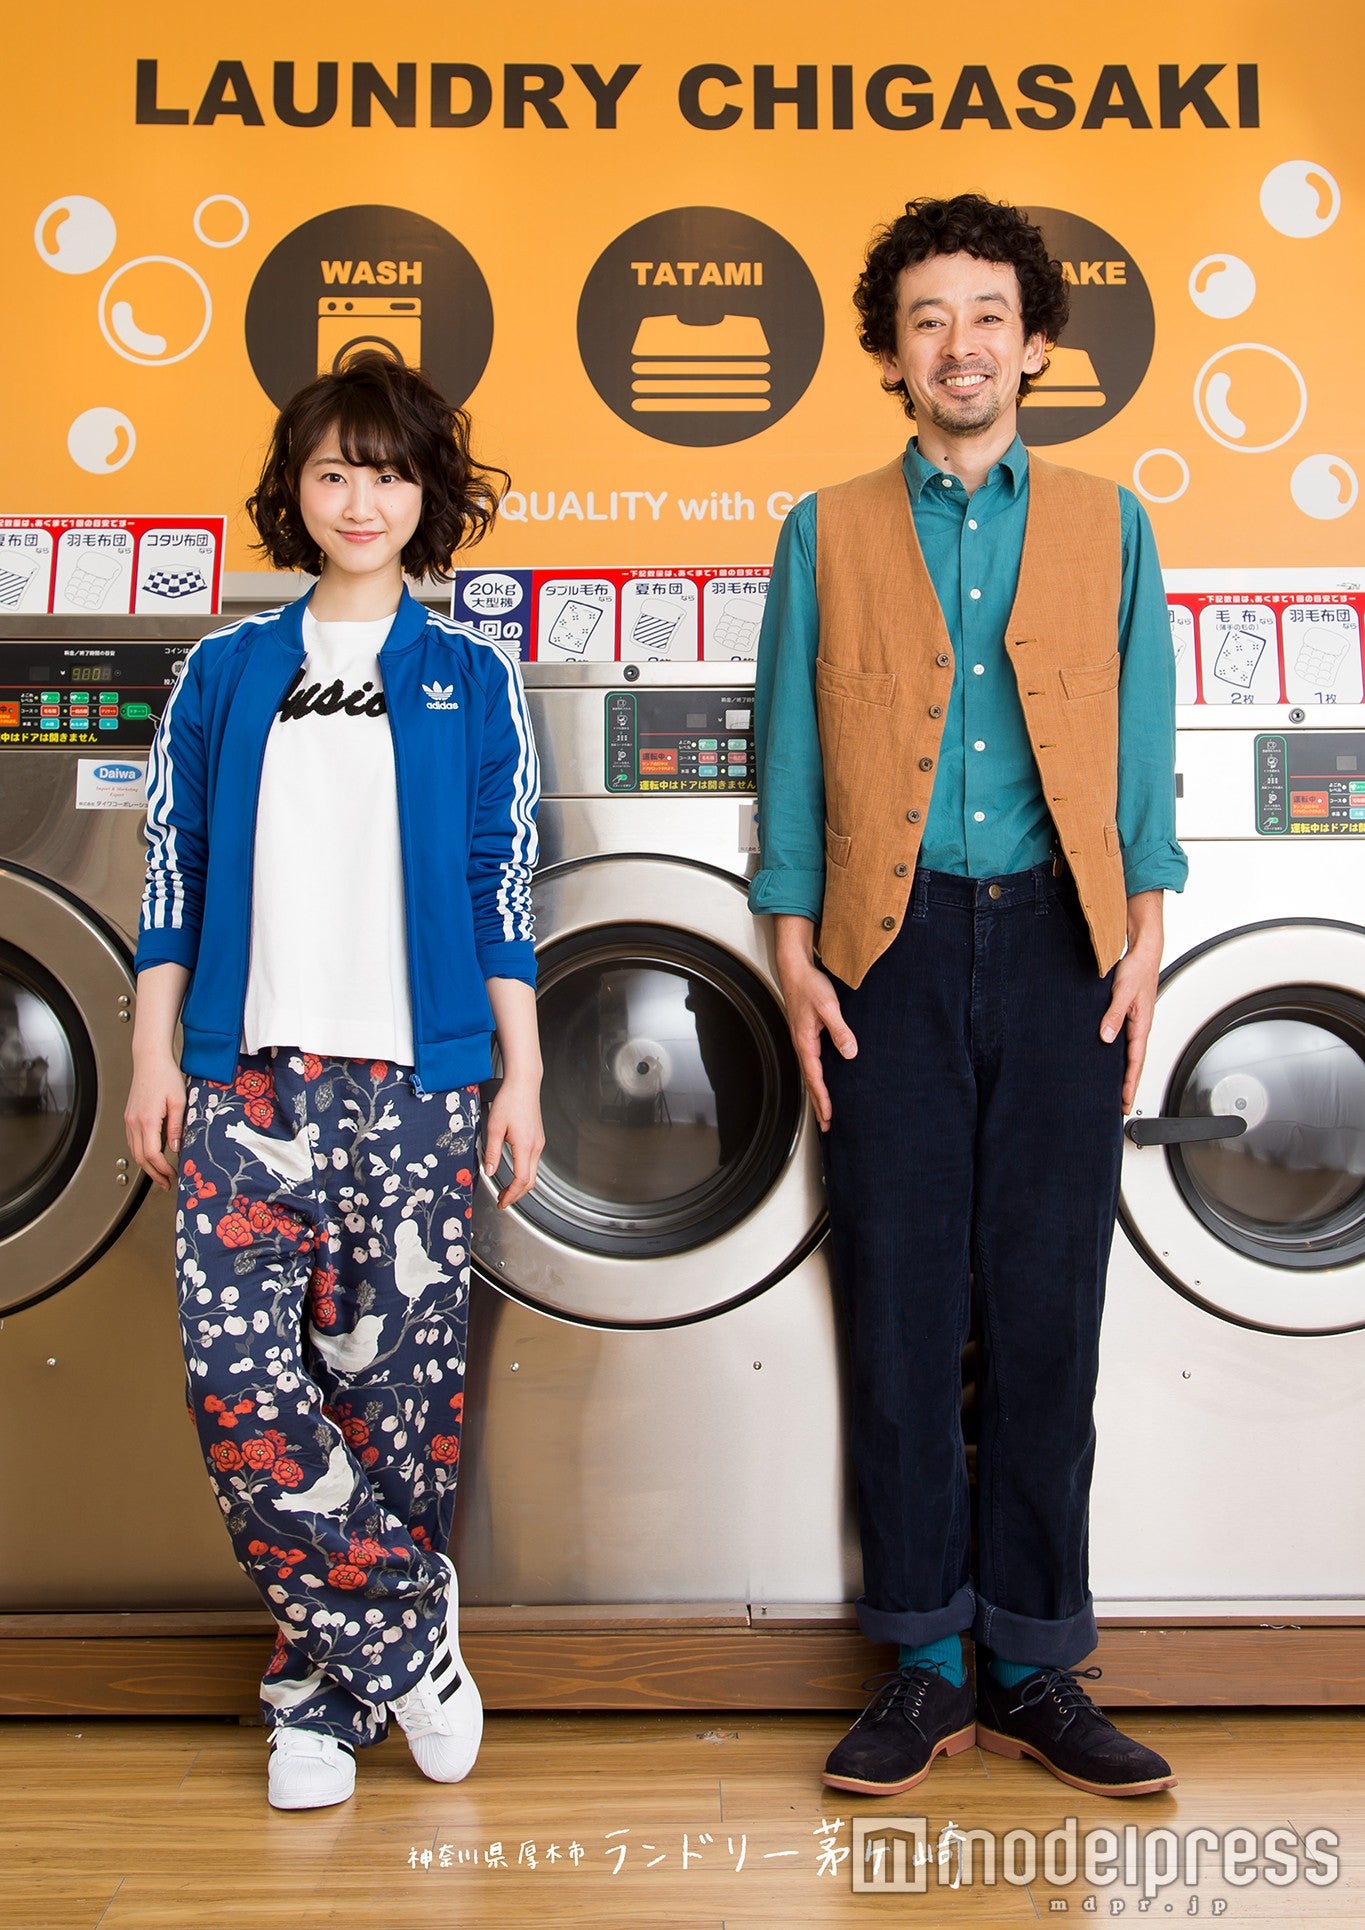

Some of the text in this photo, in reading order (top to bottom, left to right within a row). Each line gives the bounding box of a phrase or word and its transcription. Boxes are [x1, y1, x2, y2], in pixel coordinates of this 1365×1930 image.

[135, 58, 1260, 131] LAUNDRY CHIGASAKI
[321, 260, 422, 285] WASH
[631, 260, 763, 286] TATAMI
[499, 491, 668, 523] QUALITY
[678, 491, 754, 521] with
[67, 533, 127, 547] 羽毛布団
[147, 534, 208, 546] コタツ布団
[469, 582, 516, 596] 20kg
[472, 598, 513, 608] 大型機
[1290, 609, 1350, 622] 羽毛布団
[1231, 693, 1254, 704] 2枚
[1315, 692, 1337, 704] 1枚
[426, 701, 459, 710] adidas
[99, 767, 136, 779] Daiwa
